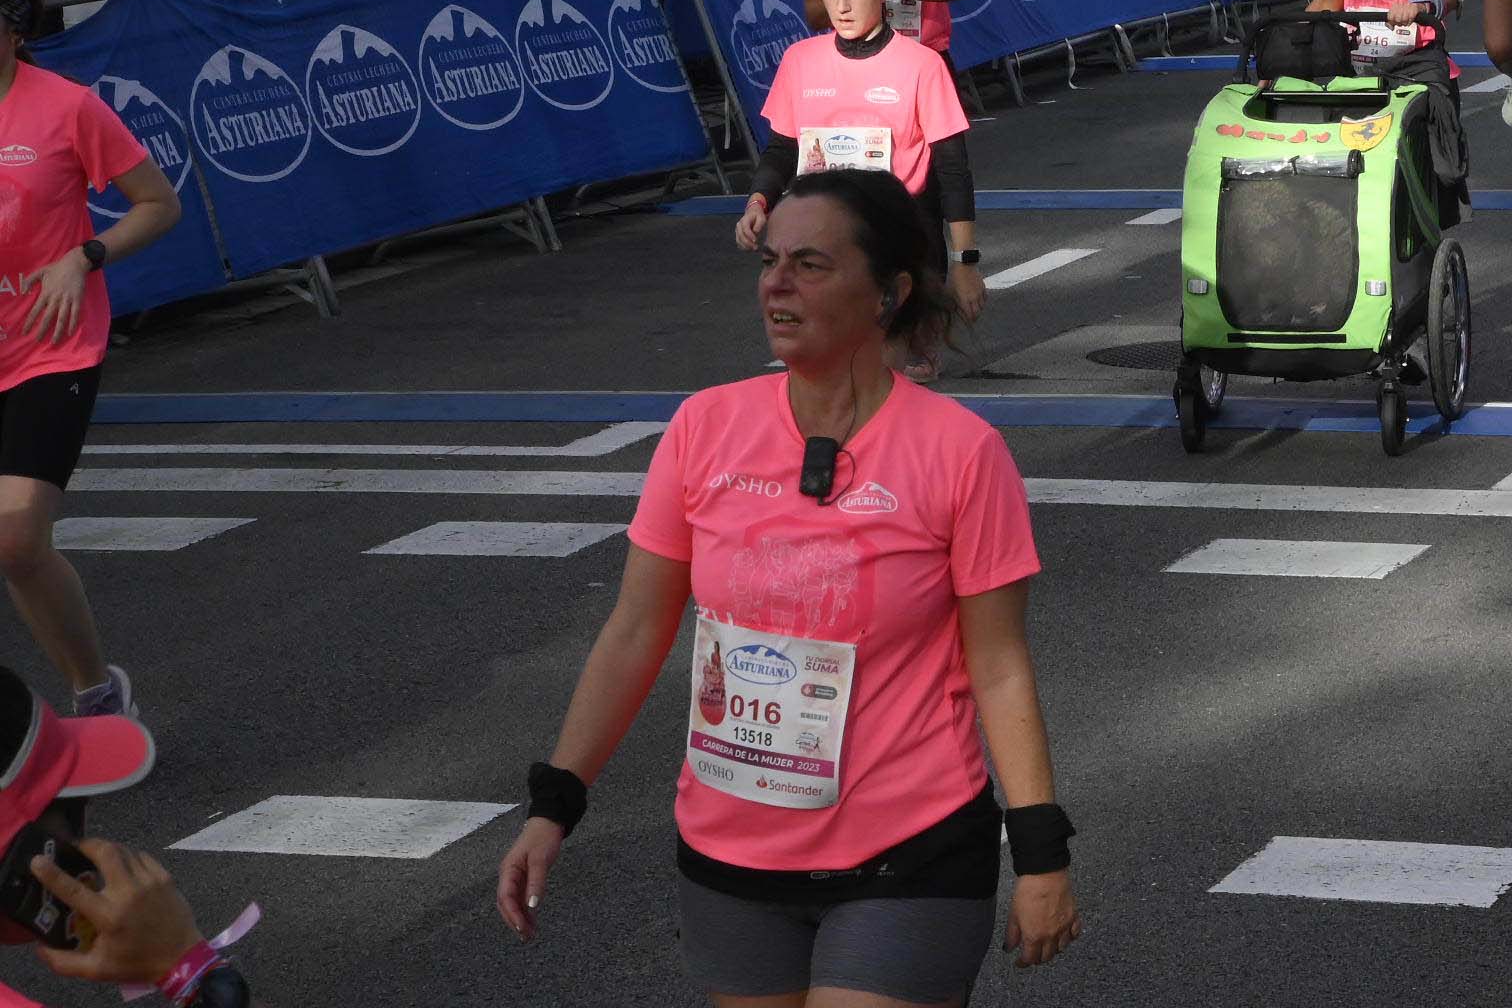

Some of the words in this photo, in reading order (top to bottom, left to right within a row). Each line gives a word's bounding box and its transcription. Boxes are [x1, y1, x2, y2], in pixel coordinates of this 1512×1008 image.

[618, 25, 678, 68] ASTUR
[1364, 35, 1388, 47] 016
[525, 40, 609, 85] ASTURIANA
[429, 56, 520, 103] ASTURIANA
[316, 80, 417, 129] ASTURIANA
[203, 102, 306, 154] ASTURIANA
[709, 472, 782, 498] OYSHO
[729, 655, 790, 679] ASTURIANA
[804, 662, 839, 674] SUMA
[729, 694, 782, 725] 016
[733, 726, 773, 746] 13518
[702, 739, 734, 757] CARRERA
[735, 749, 746, 759] DE
[747, 752, 760, 762] LA
[761, 754, 794, 768] MUJER
[797, 761, 820, 772] 2023
[698, 759, 734, 782] OYSHO
[769, 779, 823, 797] Santander
